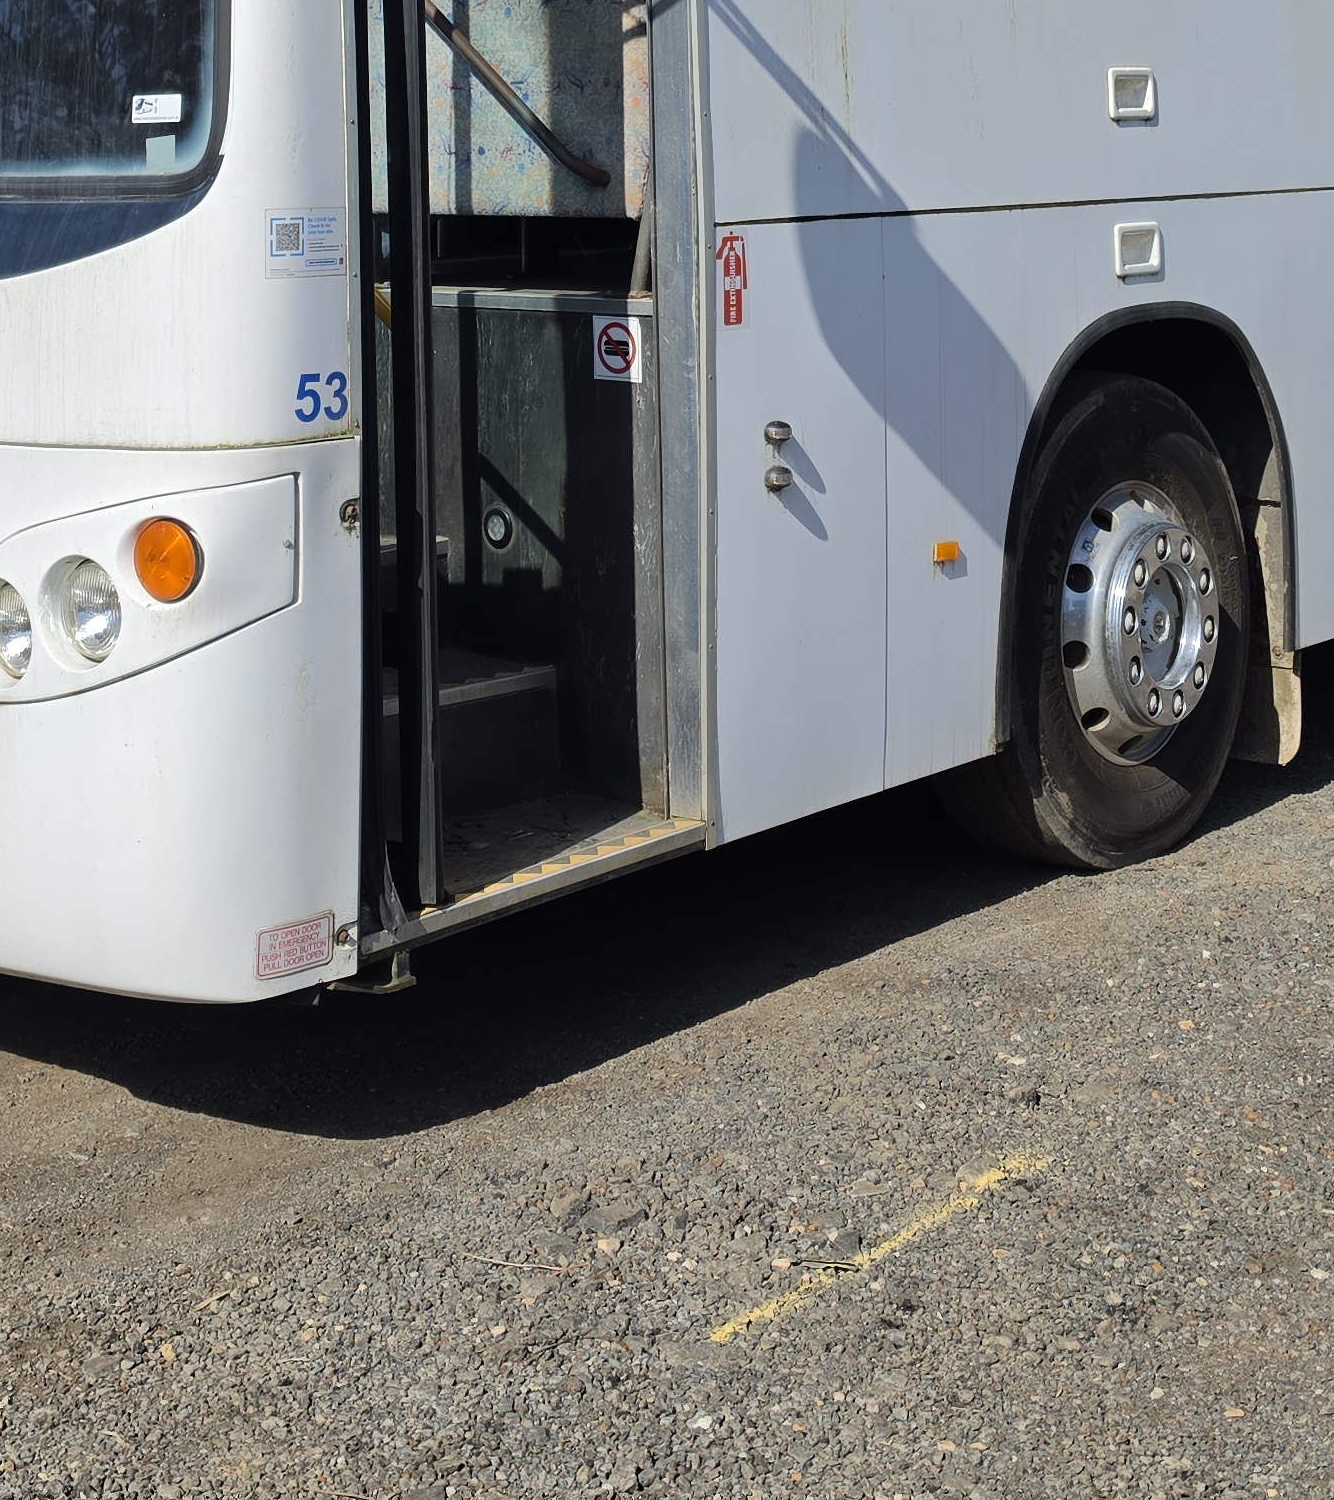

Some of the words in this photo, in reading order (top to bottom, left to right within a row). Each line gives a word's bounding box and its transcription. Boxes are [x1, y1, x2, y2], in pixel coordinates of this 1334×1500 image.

[729, 250, 737, 305] EXTINGUISHER
[729, 306, 737, 323] FIRE
[294, 371, 348, 423] 53
[269, 933, 278, 941] TO
[281, 928, 300, 939] OPEN
[302, 922, 321, 934] DOOR
[269, 943, 276, 951] IN
[279, 931, 320, 949] EMERGENCY
[262, 952, 281, 963] PUSH
[284, 948, 297, 958] RED
[300, 940, 326, 954] BUTTON
[264, 961, 281, 972] PULL
[284, 955, 304, 967] DOOR
[306, 949, 324, 961] OPEN
